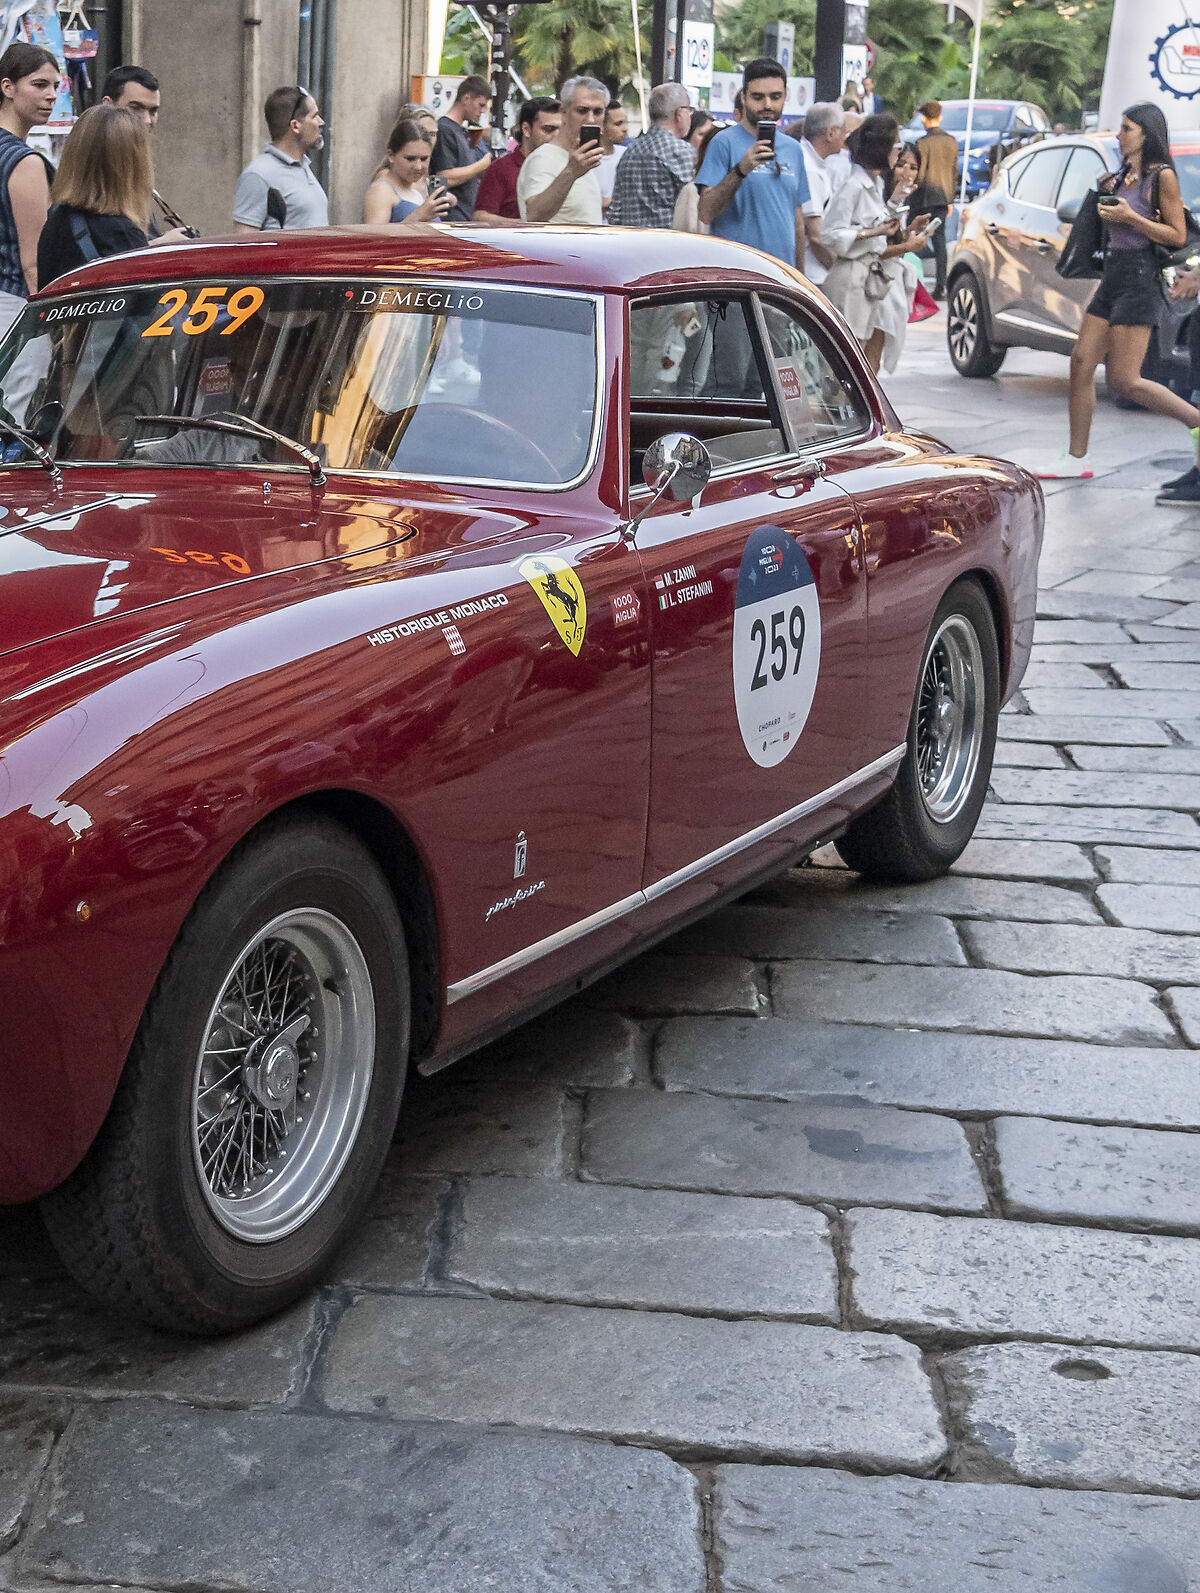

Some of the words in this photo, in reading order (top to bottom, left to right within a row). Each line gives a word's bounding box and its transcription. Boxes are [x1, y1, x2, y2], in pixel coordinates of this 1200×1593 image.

[141, 286, 265, 337] 259
[663, 572, 674, 587] M.
[673, 564, 697, 583] ZANNI
[613, 593, 633, 609] 1000
[669, 592, 677, 607] L.
[676, 579, 714, 604] STEFANINI
[366, 611, 451, 647] HISTORIQUE
[448, 593, 509, 620] MONACO
[615, 607, 637, 624] MIGLIA
[750, 605, 806, 692] 259
